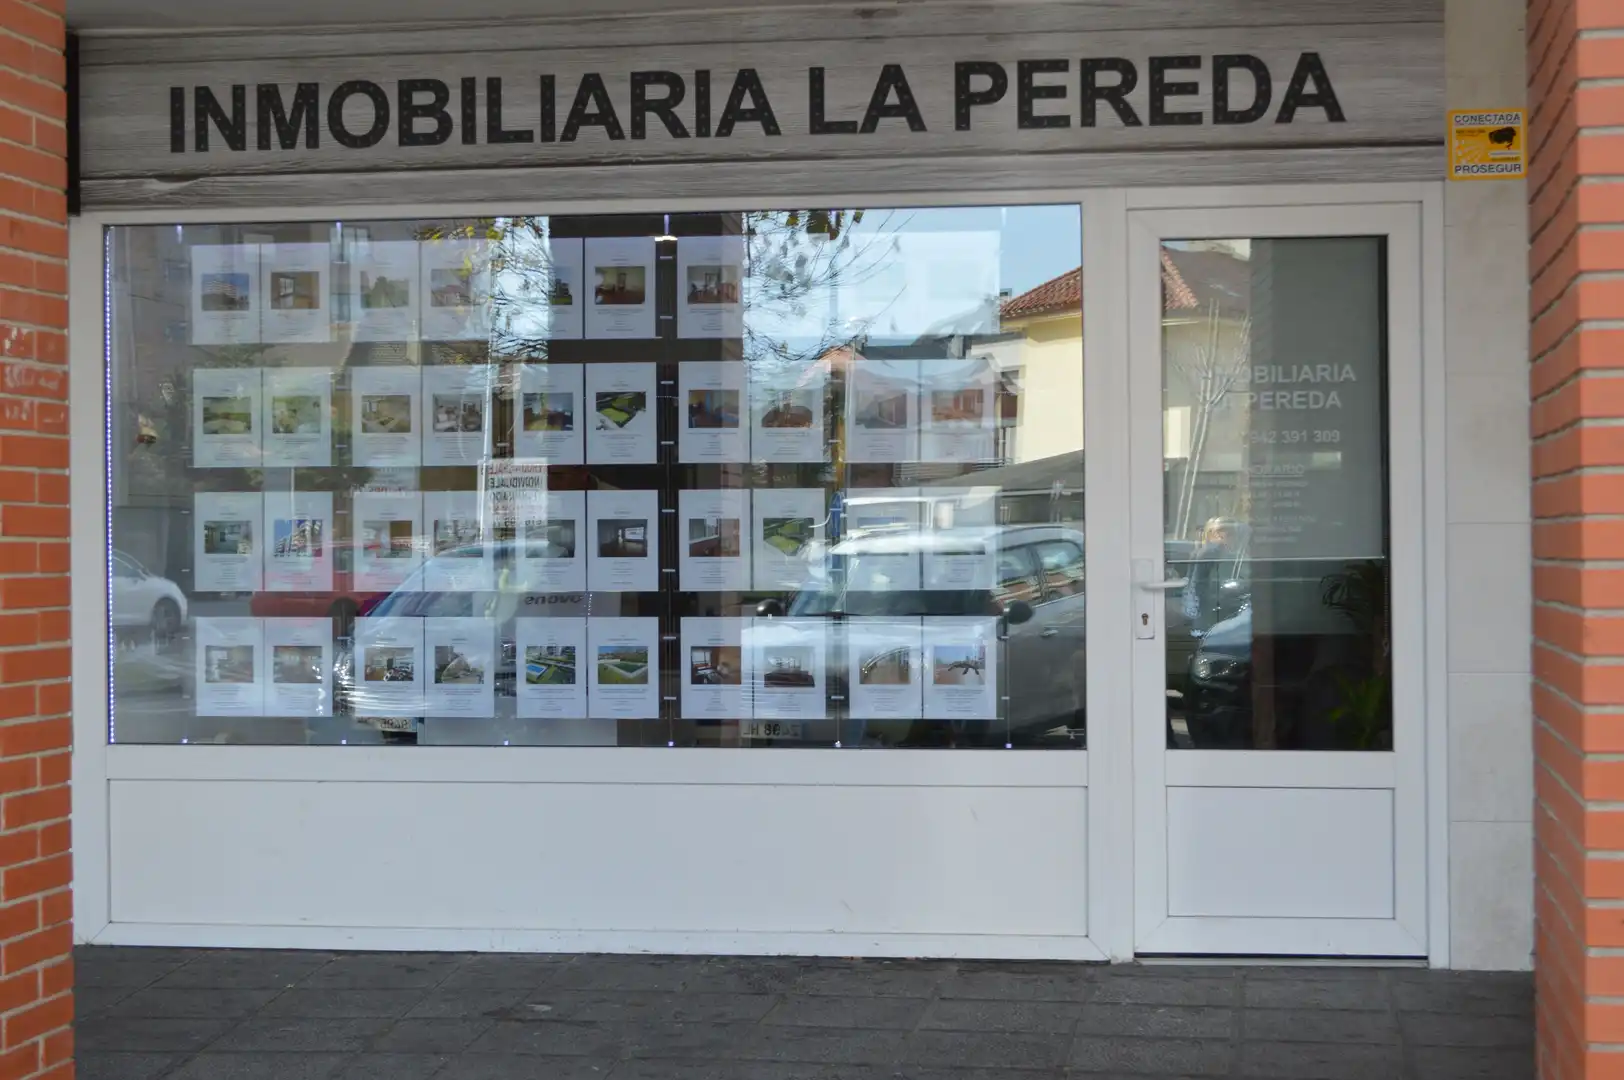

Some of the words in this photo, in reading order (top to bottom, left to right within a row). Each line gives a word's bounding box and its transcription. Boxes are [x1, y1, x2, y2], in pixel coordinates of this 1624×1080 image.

[170, 68, 781, 153] INMOBILIARIA
[808, 64, 927, 134] LA
[954, 52, 1346, 131] PEREDA
[1454, 113, 1521, 123] CONECTADA
[1454, 163, 1522, 174] PROSEGUR
[1247, 391, 1343, 410] PEREDA
[1251, 429, 1277, 444] 942
[1281, 429, 1308, 443] 391
[1313, 428, 1341, 443] 309
